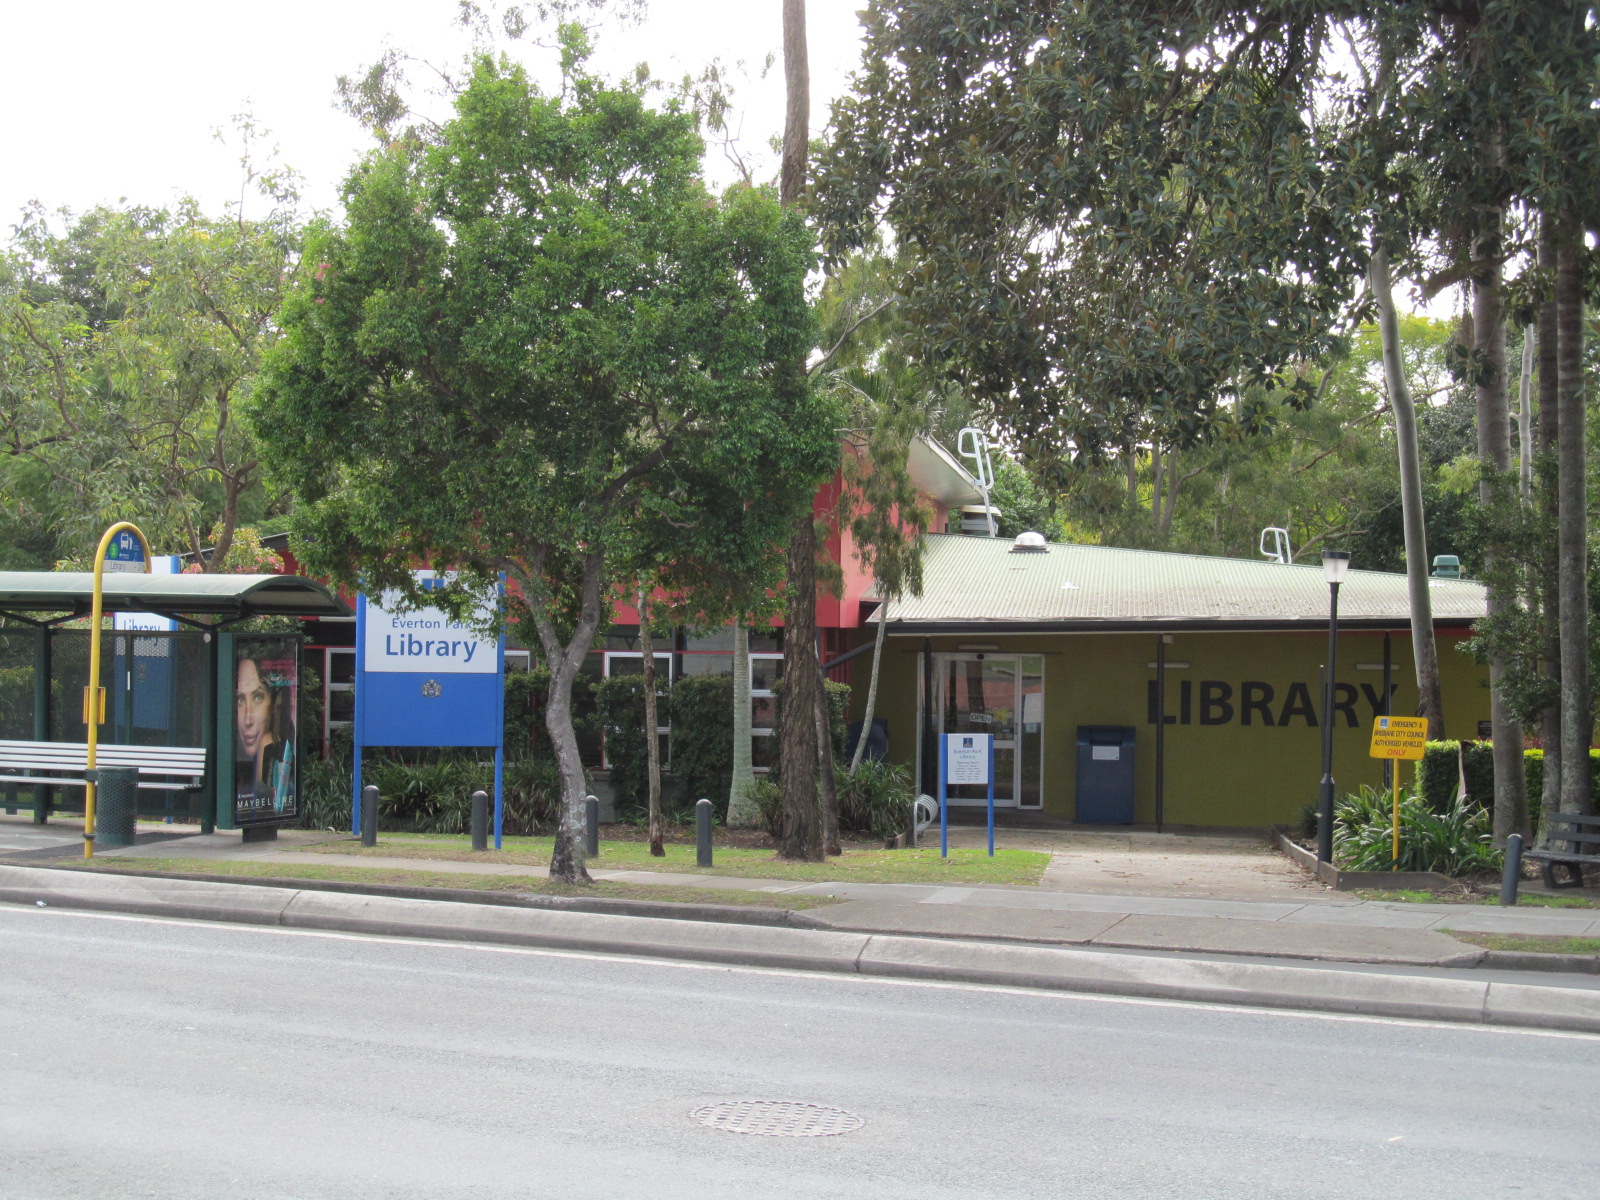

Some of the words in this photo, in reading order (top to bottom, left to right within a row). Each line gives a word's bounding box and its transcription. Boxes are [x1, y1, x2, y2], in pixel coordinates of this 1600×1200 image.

[110, 561, 126, 571] Library
[392, 618, 440, 628] Everton
[386, 633, 478, 663] Library
[1147, 679, 1399, 728] LIBRARY
[971, 713, 990, 722] OPEN
